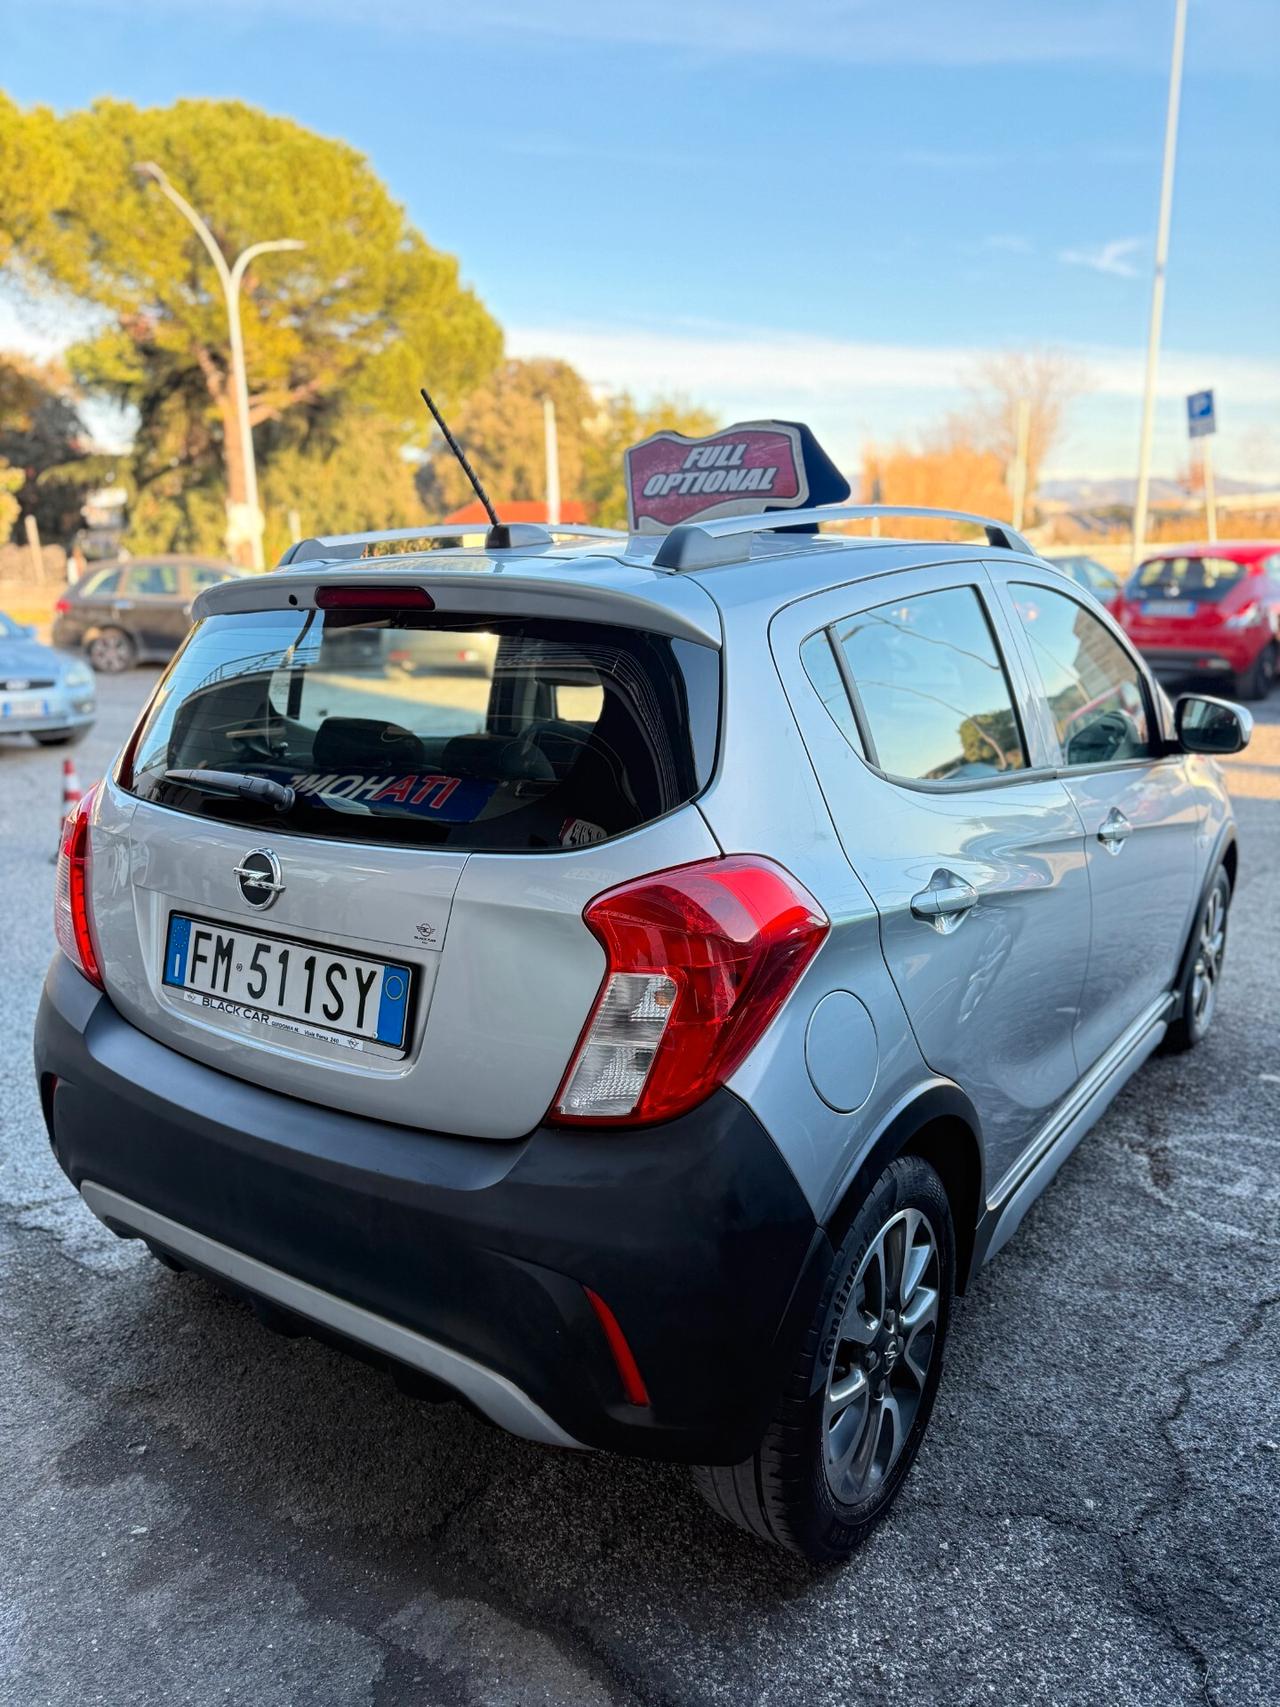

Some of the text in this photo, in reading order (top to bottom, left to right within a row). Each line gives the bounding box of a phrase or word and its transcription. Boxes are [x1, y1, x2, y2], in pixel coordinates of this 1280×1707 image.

[683, 443, 747, 470] FULL
[643, 467, 777, 497] OPTIONAL
[191, 930, 377, 1028] FM 511SY
[202, 997, 270, 1024] BLACK CAR
